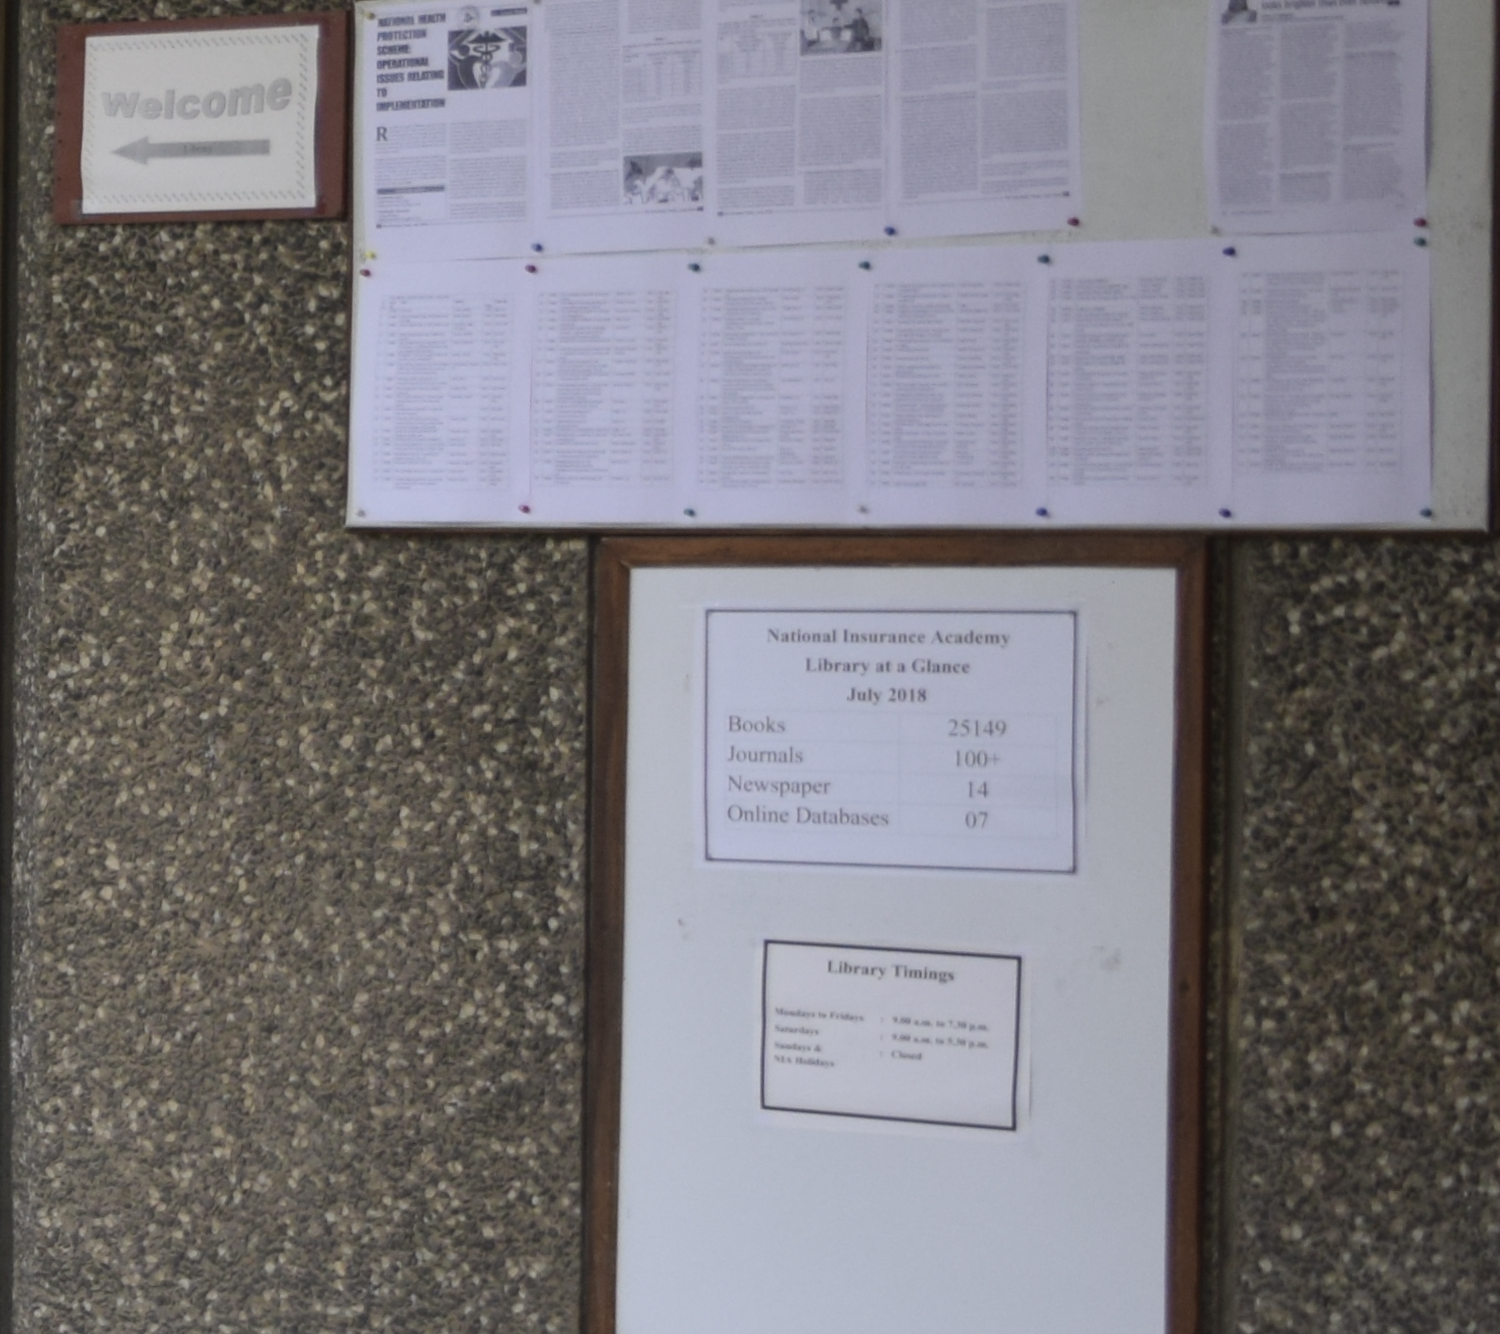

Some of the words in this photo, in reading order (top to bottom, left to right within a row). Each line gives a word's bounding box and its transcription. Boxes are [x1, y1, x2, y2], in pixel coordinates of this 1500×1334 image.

[377, 16, 415, 28] NATIONAL
[418, 12, 447, 25] HEALTH
[377, 29, 427, 41] PROTECTION
[376, 57, 429, 69] OPERATIONAL
[376, 71, 405, 84] ISSUES
[407, 69, 445, 82] RELATING
[101, 77, 293, 121] Welcome
[376, 87, 388, 98] TO
[376, 98, 446, 112] IMPLEMENTATION
[767, 628, 838, 645] National
[842, 629, 926, 645] Insurance
[931, 629, 1011, 648] Academy
[805, 657, 870, 676] Library
[875, 659, 893, 674] at
[896, 662, 906, 674] a
[911, 658, 971, 675] Glance
[846, 687, 882, 705] July
[887, 688, 928, 703] 2018
[727, 715, 786, 734] Books
[947, 719, 1007, 738] 25149
[727, 746, 804, 765] Journals
[955, 750, 1001, 768] 100+
[727, 775, 831, 798] Newspaper
[966, 781, 989, 799] 14
[726, 804, 790, 824] Online
[795, 806, 890, 828] Databases
[964, 811, 989, 830] 07
[827, 960, 887, 980] Library
[891, 965, 955, 984] Timings
[774, 1007, 816, 1021] Mondays
[817, 1009, 827, 1019] to
[829, 1011, 865, 1023] Fridays
[935, 1019, 946, 1029] to
[774, 1024, 820, 1037] Saturdays
[935, 1036, 945, 1046] to
[774, 1041, 815, 1054] Sundays
[891, 1050, 923, 1061] Closed
[794, 1055, 835, 1068] Holidays
